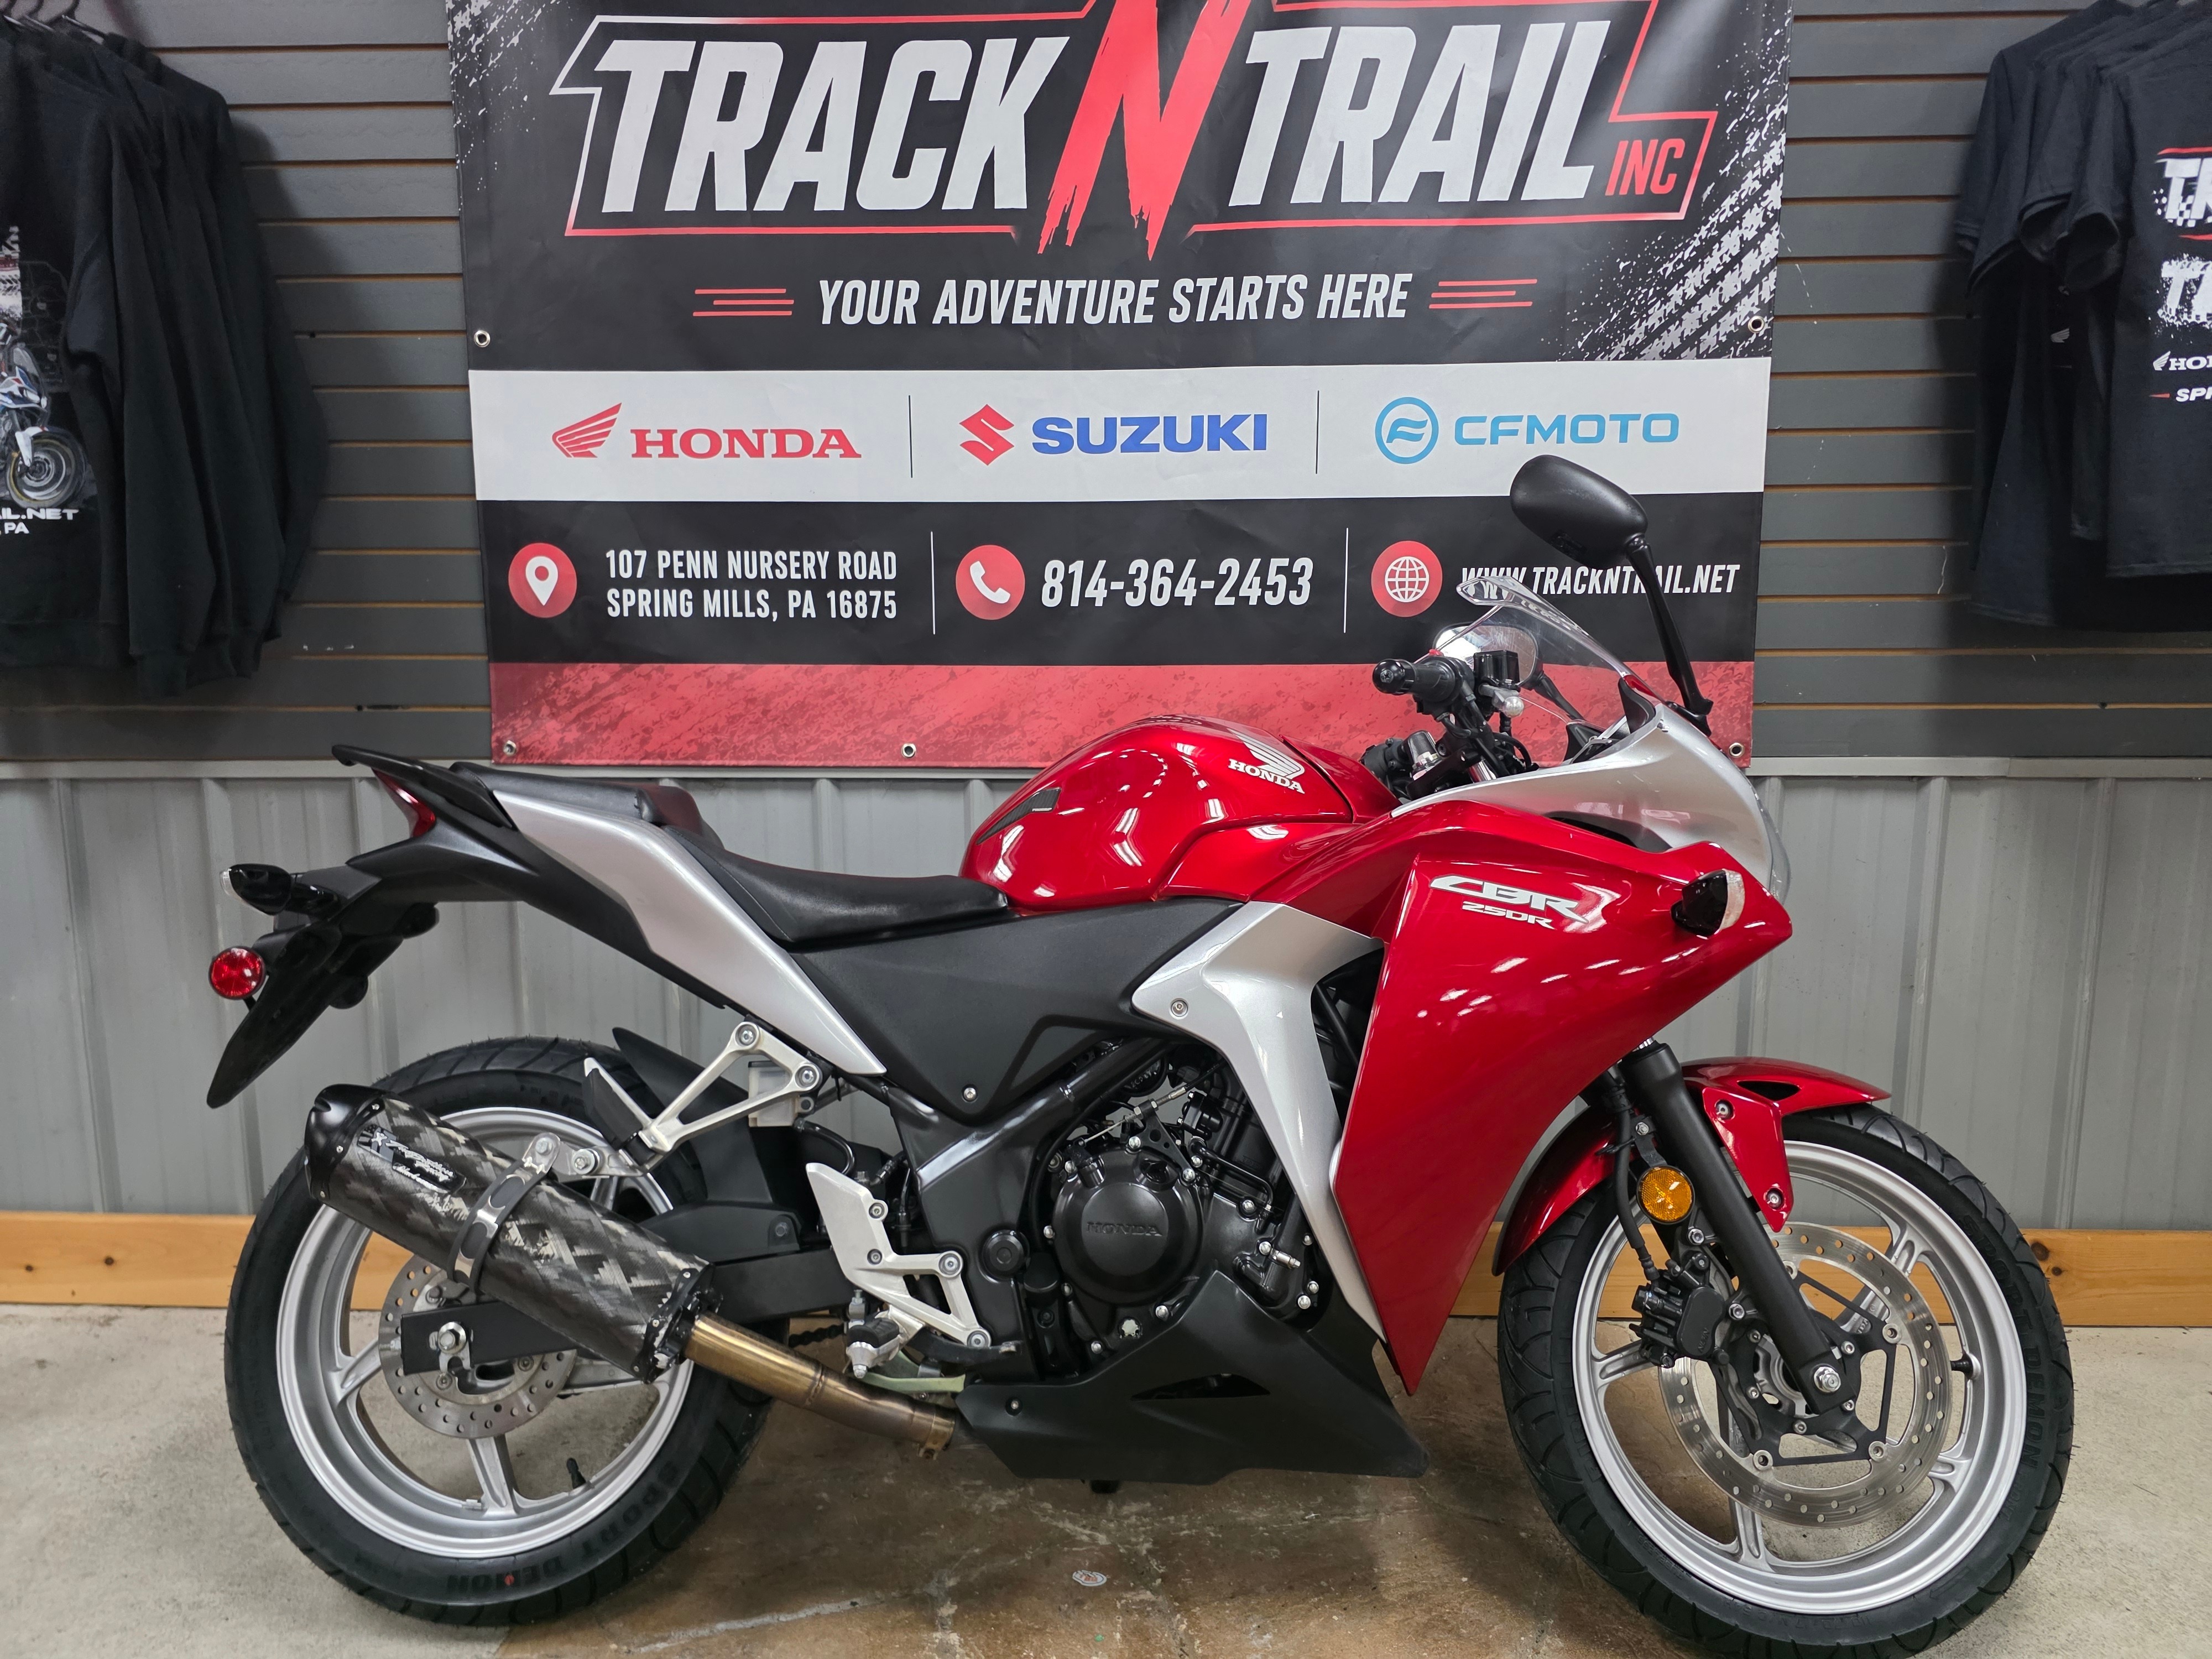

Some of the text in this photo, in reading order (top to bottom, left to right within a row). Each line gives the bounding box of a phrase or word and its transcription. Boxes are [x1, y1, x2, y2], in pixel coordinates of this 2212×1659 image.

[594, 0, 1685, 260] TRACK N TRAIL INC
[819, 273, 1413, 325] YOUR ADVENTURE STARTS HERE
[630, 428, 862, 460] HONDA
[1032, 414, 1267, 455] SUZUKI
[1454, 413, 1679, 445] CFMOTO
[0, 507, 79, 520] IL.NET
[4, 521, 30, 534] PA
[606, 550, 897, 580] 107 PENN NURSERY ROAD
[1041, 557, 1314, 607] 814-364-2453
[607, 588, 897, 622] SPRING MILLS, PA 16875
[1228, 758, 1305, 794] HONDA
[1429, 874, 1589, 924] CBR
[1086, 1221, 1162, 1237] HONDA
[2020, 1346, 2046, 1469] DEMON
